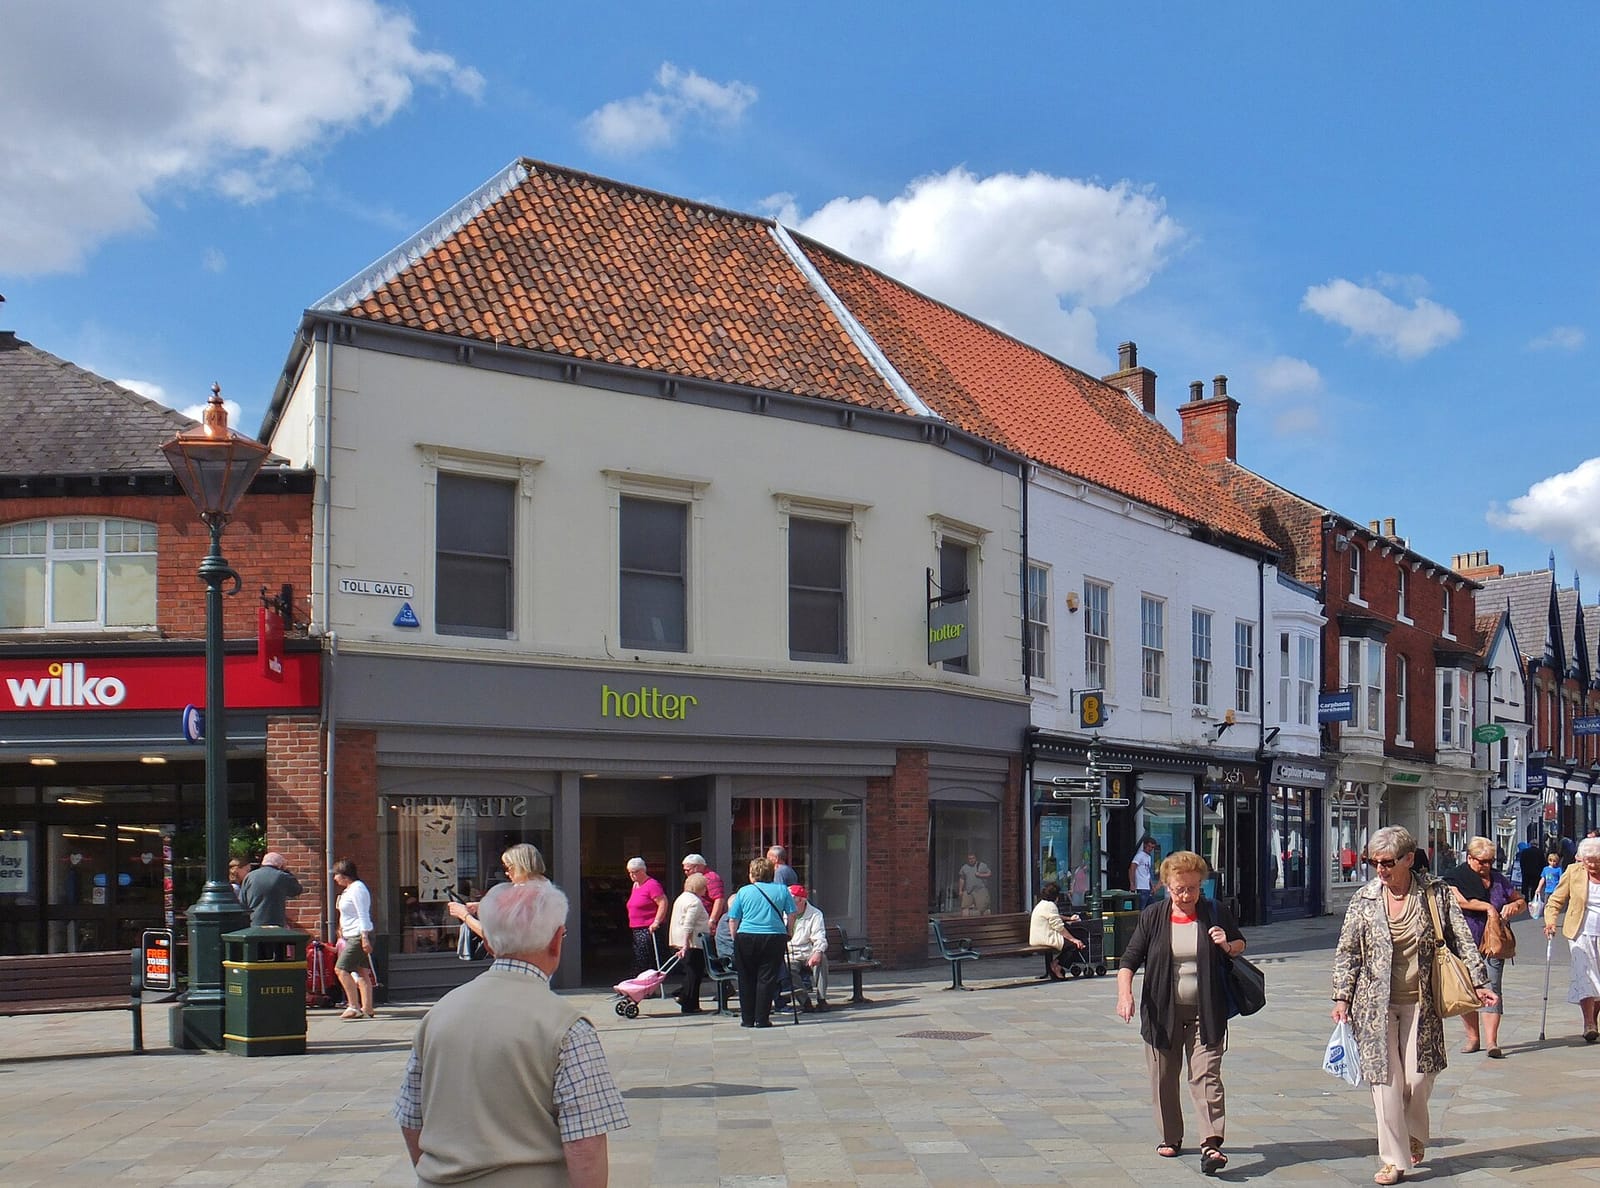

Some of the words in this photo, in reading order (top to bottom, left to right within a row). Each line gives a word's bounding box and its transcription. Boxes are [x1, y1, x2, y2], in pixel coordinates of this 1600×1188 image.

[343, 581, 370, 593] TOLL
[374, 583, 410, 596] GAVEL
[929, 623, 965, 643] hotter
[5, 662, 126, 707] wilko
[601, 684, 698, 720] hotter
[260, 986, 294, 995] LITTER
